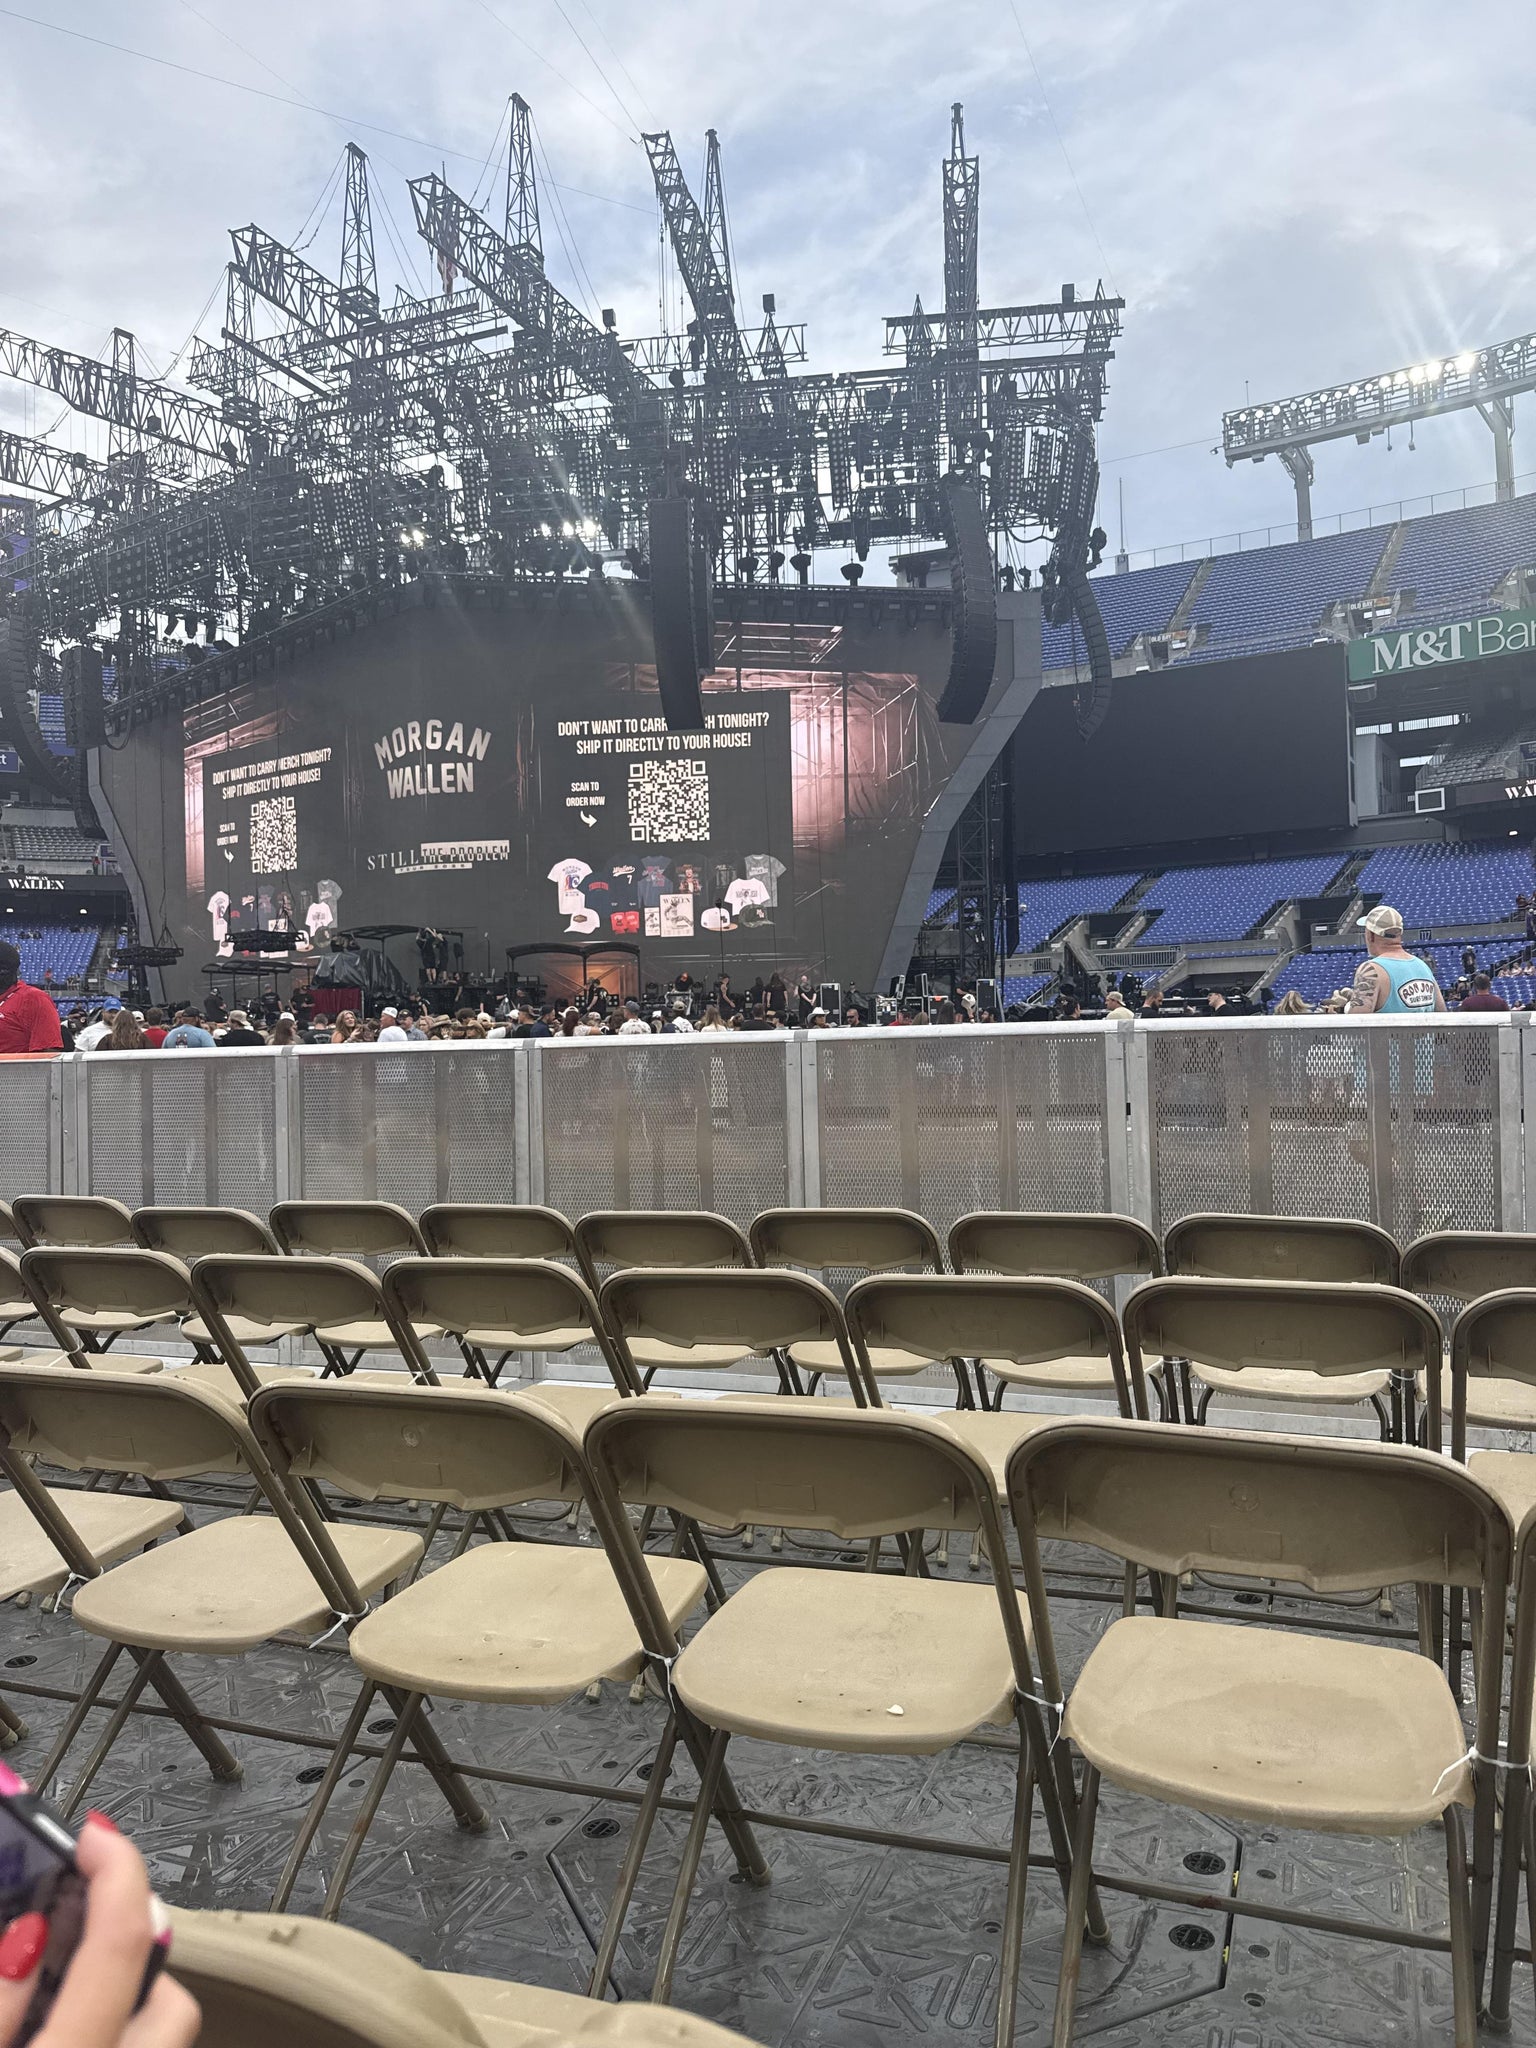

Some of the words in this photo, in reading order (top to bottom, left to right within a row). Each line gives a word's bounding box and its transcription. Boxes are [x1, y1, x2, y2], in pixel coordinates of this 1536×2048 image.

[1370, 621, 1472, 674] M&T
[558, 721, 589, 736] DON'T
[591, 720, 622, 735] WANT
[624, 718, 638, 733] TO
[640, 717, 668, 732] CARR
[717, 712, 770, 729] TONIGHT?
[374, 719, 492, 770] MORGAN
[576, 739, 601, 754] SHIP
[603, 739, 613, 753] IT
[615, 736, 664, 753] DIRECTLY
[666, 735, 680, 750] TO
[682, 734, 710, 750] YOUR
[712, 732, 752, 748] HOUSE!
[212, 769, 231, 785] DON'T
[230, 765, 248, 781] WANT
[248, 764, 256, 778] TO
[257, 759, 277, 775] CARRY
[300, 747, 332, 766] TONIGHT?
[222, 786, 236, 800] SHIP
[237, 785, 242, 797] IT
[243, 778, 271, 795] DIRECTLY
[271, 776, 280, 789] TO
[280, 773, 297, 788] YOUR
[298, 767, 321, 785] HOUSE!
[387, 762, 474, 800] WALLEN
[571, 782, 589, 792] SCAN
[590, 781, 599, 791] TO
[566, 796, 588, 807] ORDER
[589, 795, 605, 806] NOW
[367, 849, 419, 871] STILL
[422, 847, 444, 863] THE
[450, 844, 509, 862] PROBLEM
[8, 879, 64, 890] WALLEN
[627, 875, 633, 884] 7
[1402, 983, 1419, 1000] RON
